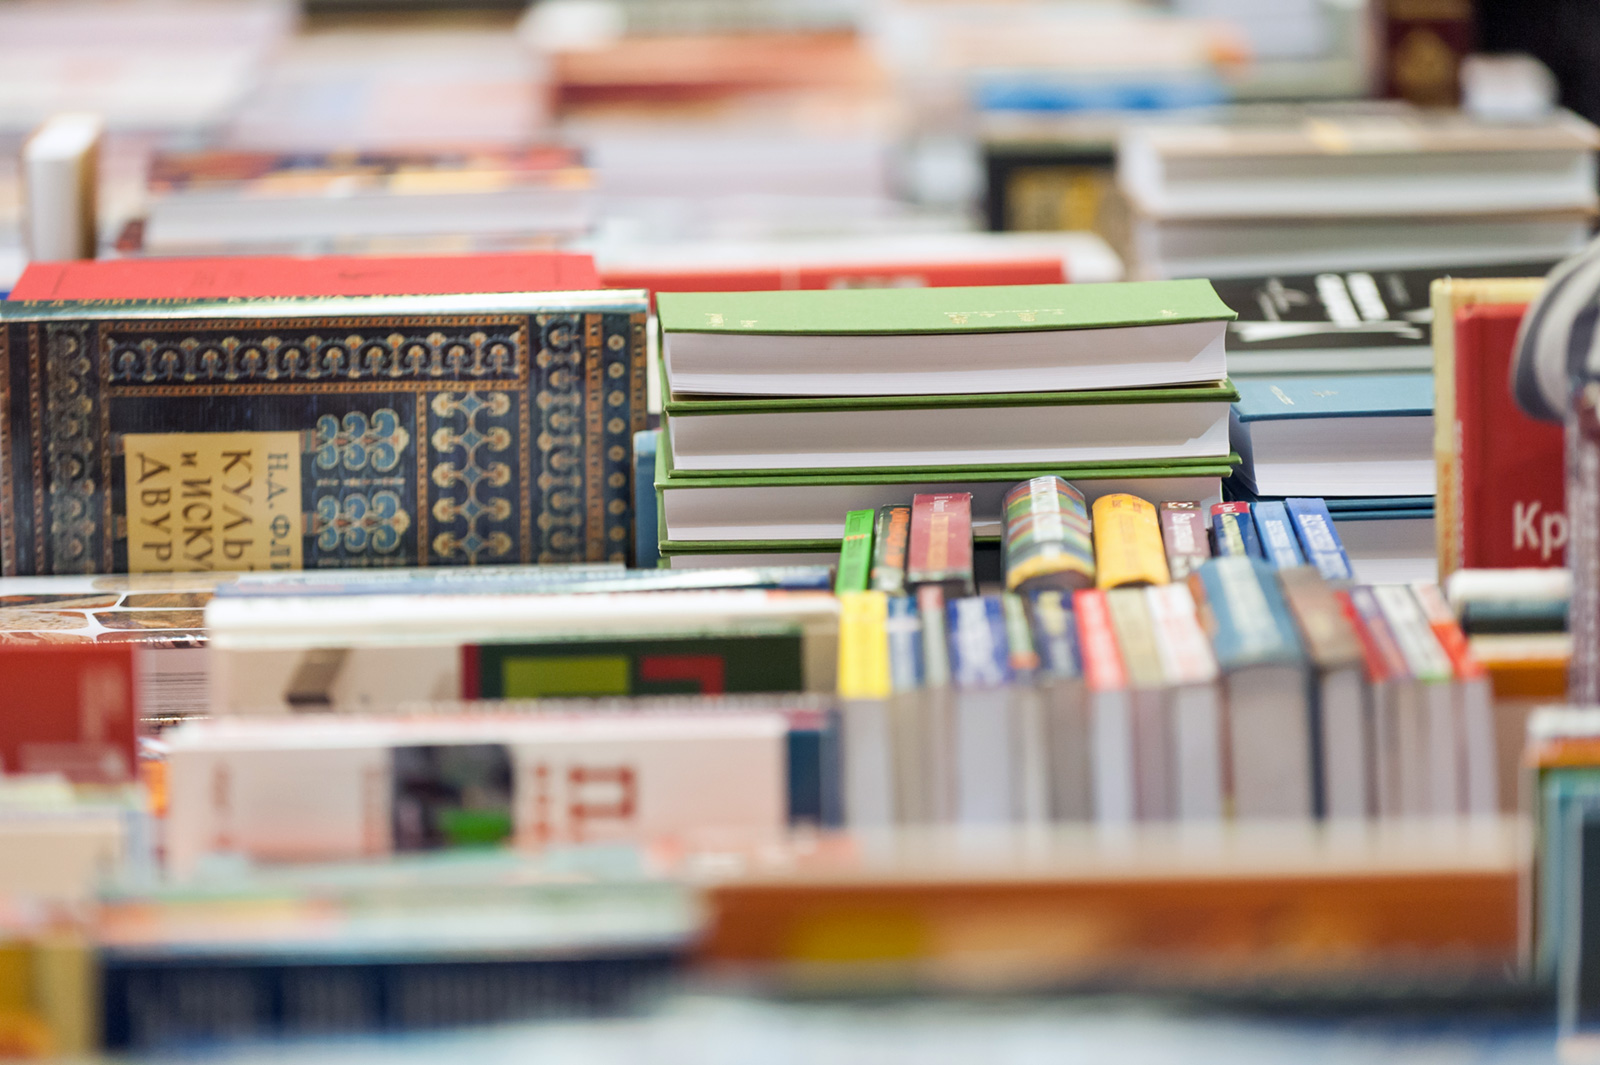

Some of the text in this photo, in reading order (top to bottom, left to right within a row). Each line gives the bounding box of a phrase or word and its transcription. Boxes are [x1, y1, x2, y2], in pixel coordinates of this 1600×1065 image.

[136, 452, 173, 574] ДВУР
[181, 477, 214, 572] ИСКУ
[221, 449, 254, 571] КУЛЬ
